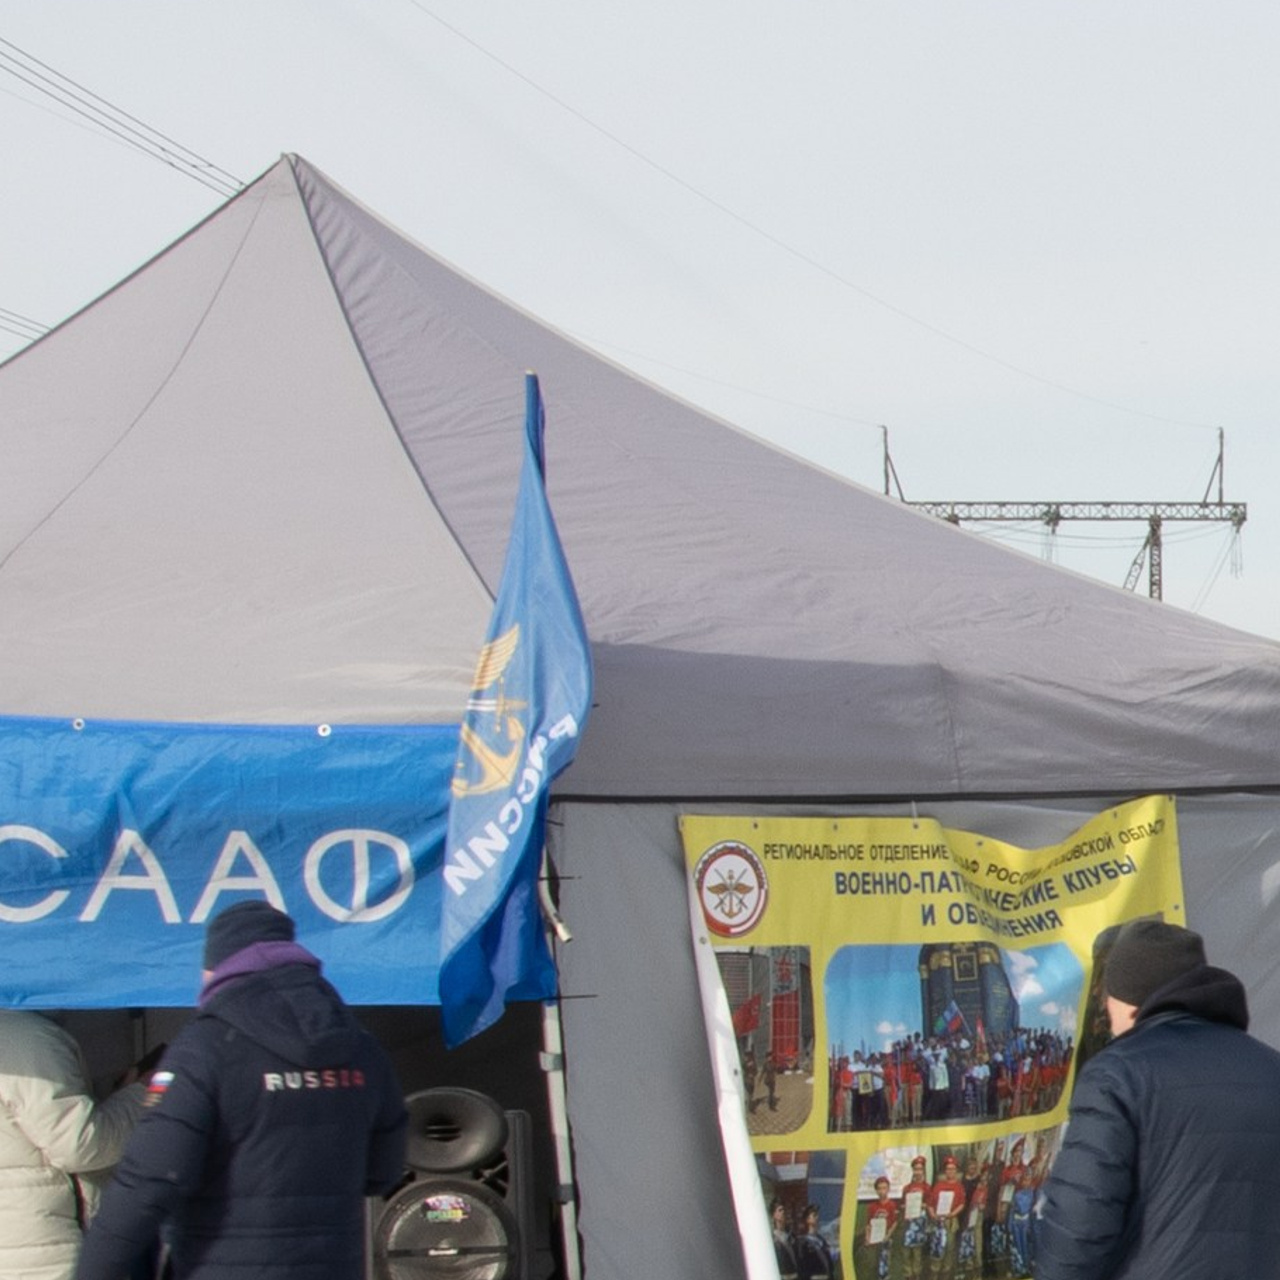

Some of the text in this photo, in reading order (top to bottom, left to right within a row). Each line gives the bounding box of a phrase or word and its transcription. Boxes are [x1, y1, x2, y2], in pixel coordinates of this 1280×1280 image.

[763, 843, 865, 861] РЕГИОНАЛЬНОЕ
[869, 844, 949, 862] ОТДЕЛЕНИЕ
[1063, 854, 1137, 894] КЛУБЫ
[921, 903, 936, 927] И
[263, 1069, 366, 1092] RUSSIA
